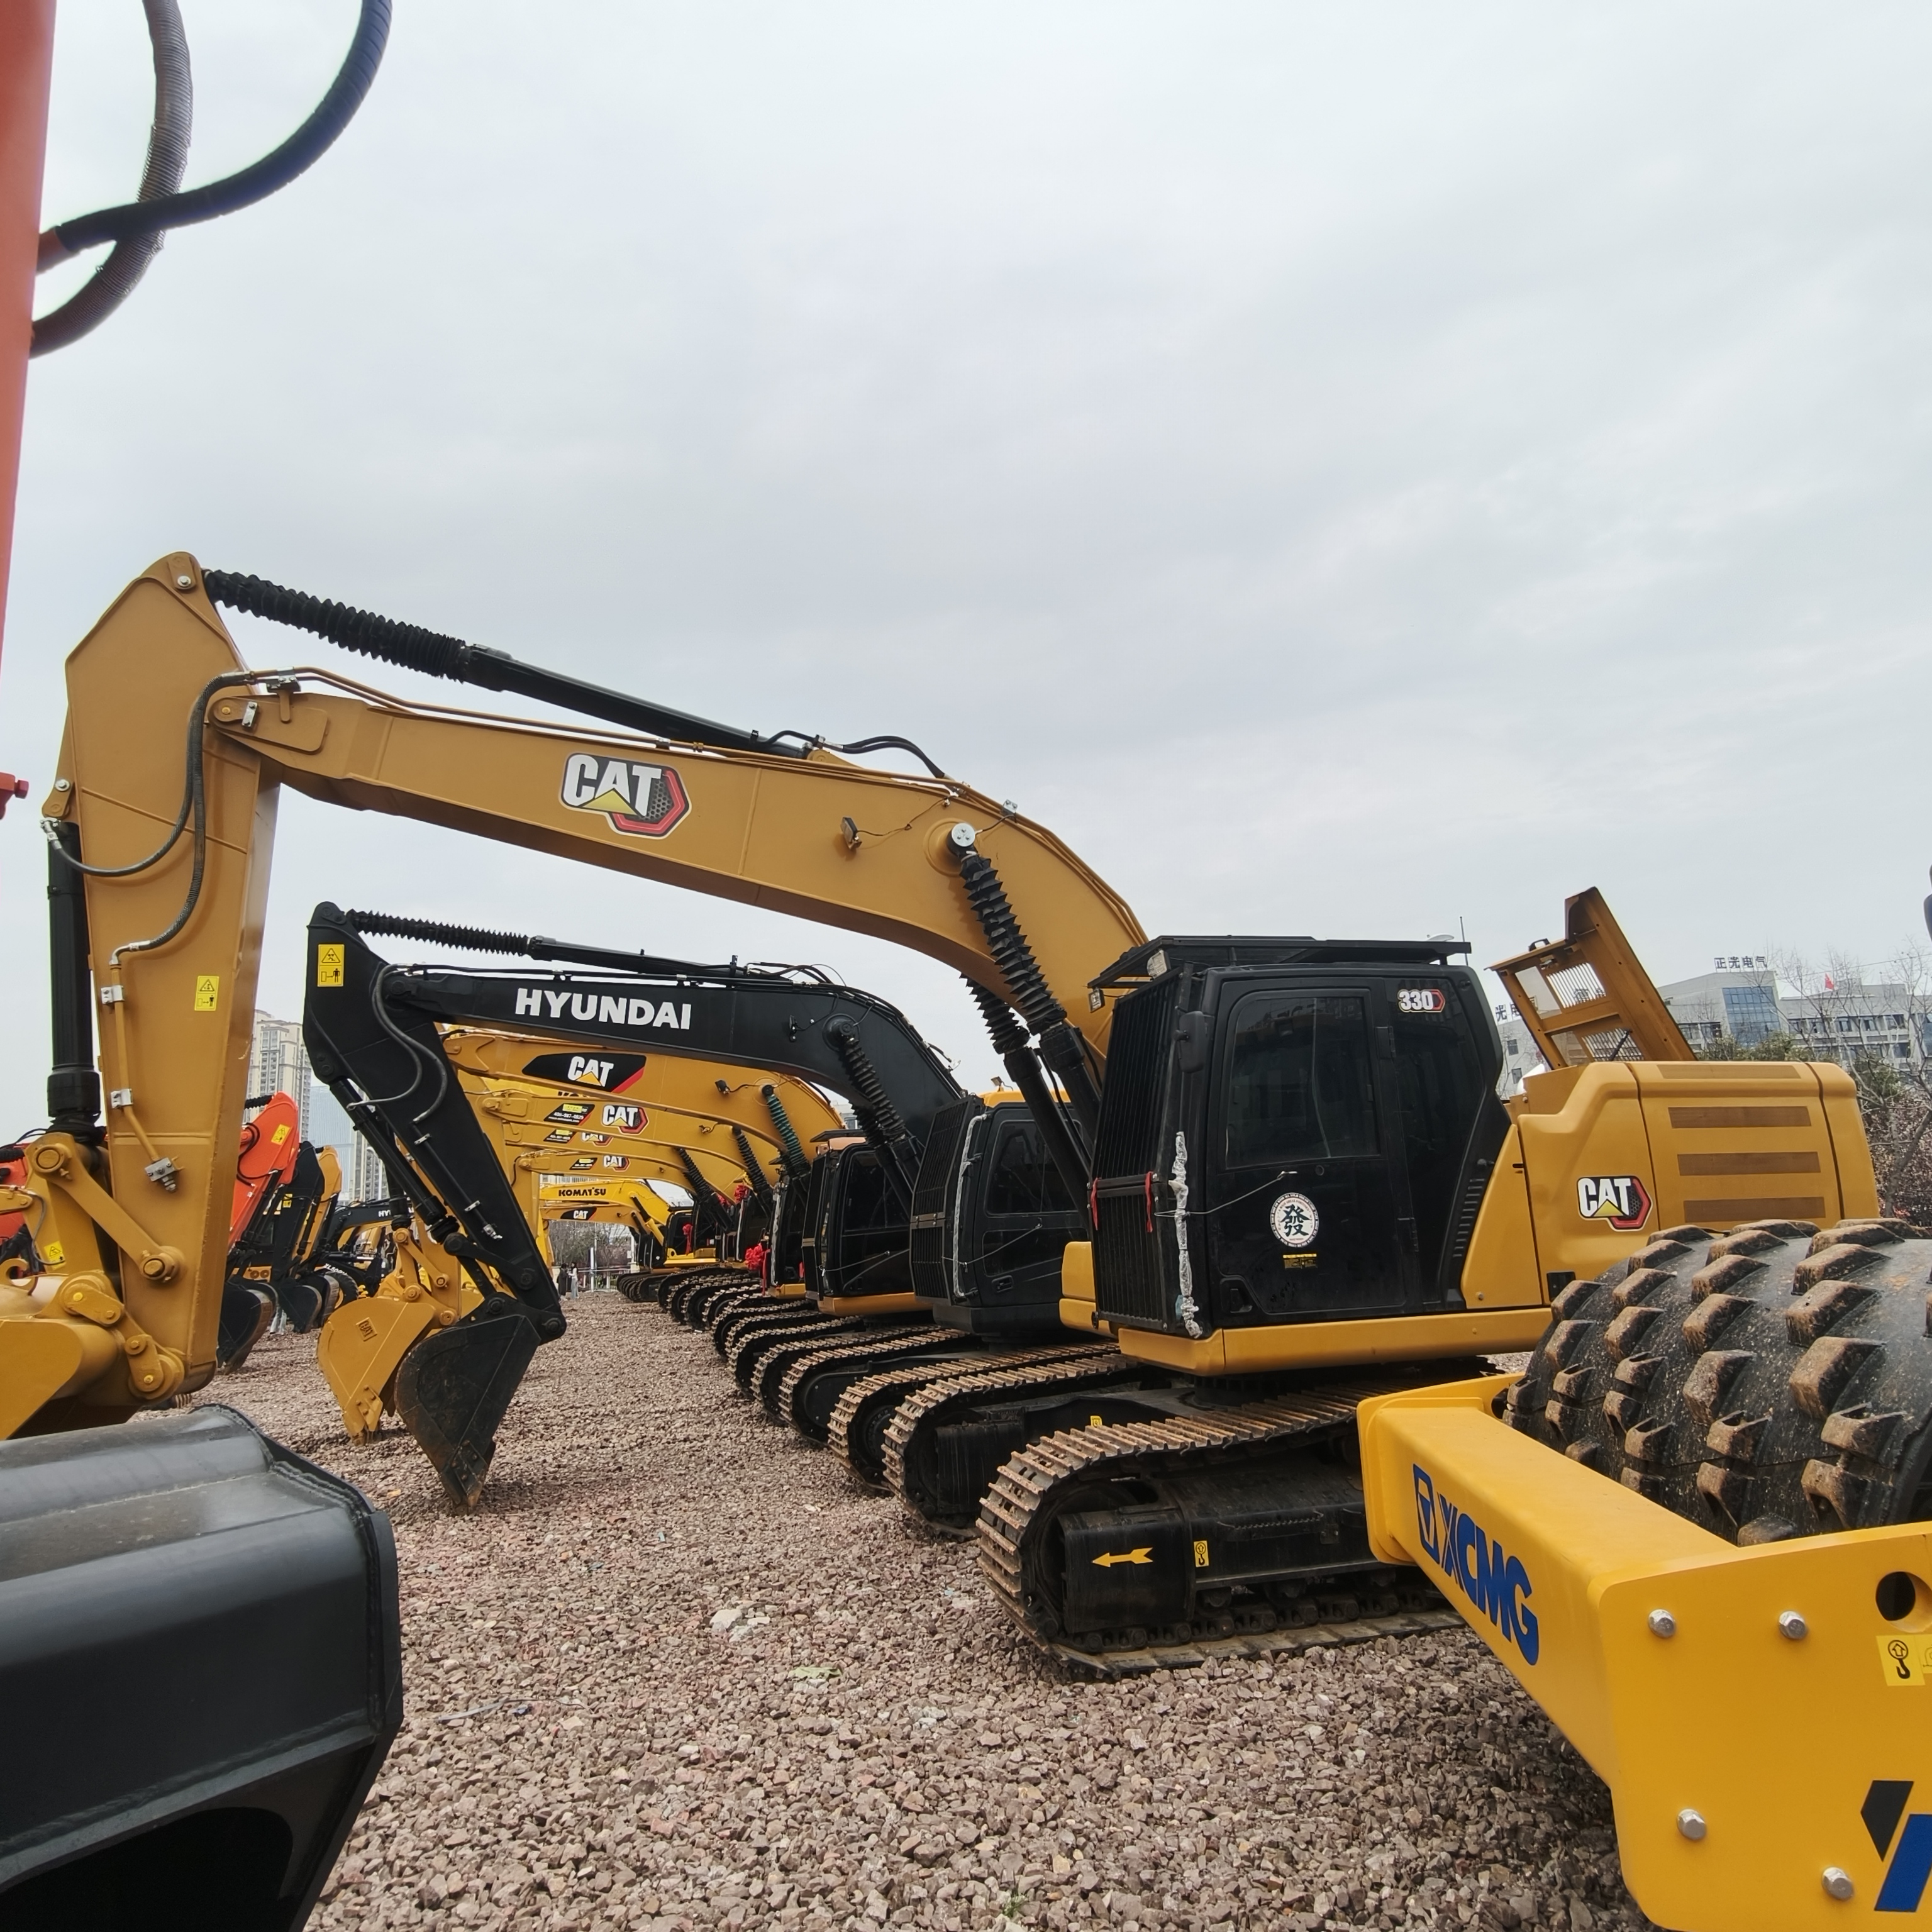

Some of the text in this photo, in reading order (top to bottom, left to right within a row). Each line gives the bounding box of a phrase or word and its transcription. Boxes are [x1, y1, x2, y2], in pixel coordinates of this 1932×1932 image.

[563, 754, 662, 817] CAT
[1714, 955, 1768, 969] 正光电气
[514, 987, 692, 1030] HYUNDAI
[1399, 991, 1433, 1010] 330
[567, 1056, 614, 1087] CAT
[602, 1104, 638, 1128] CAT
[603, 1155, 623, 1168] CAT
[558, 1187, 606, 1197] KOMATSU
[1577, 1177, 1631, 1217] CAT
[573, 1210, 589, 1219] CAT
[1280, 1204, 1311, 1237] 發
[358, 1320, 373, 1338] CAT
[1436, 1491, 1540, 1666] XCMG
